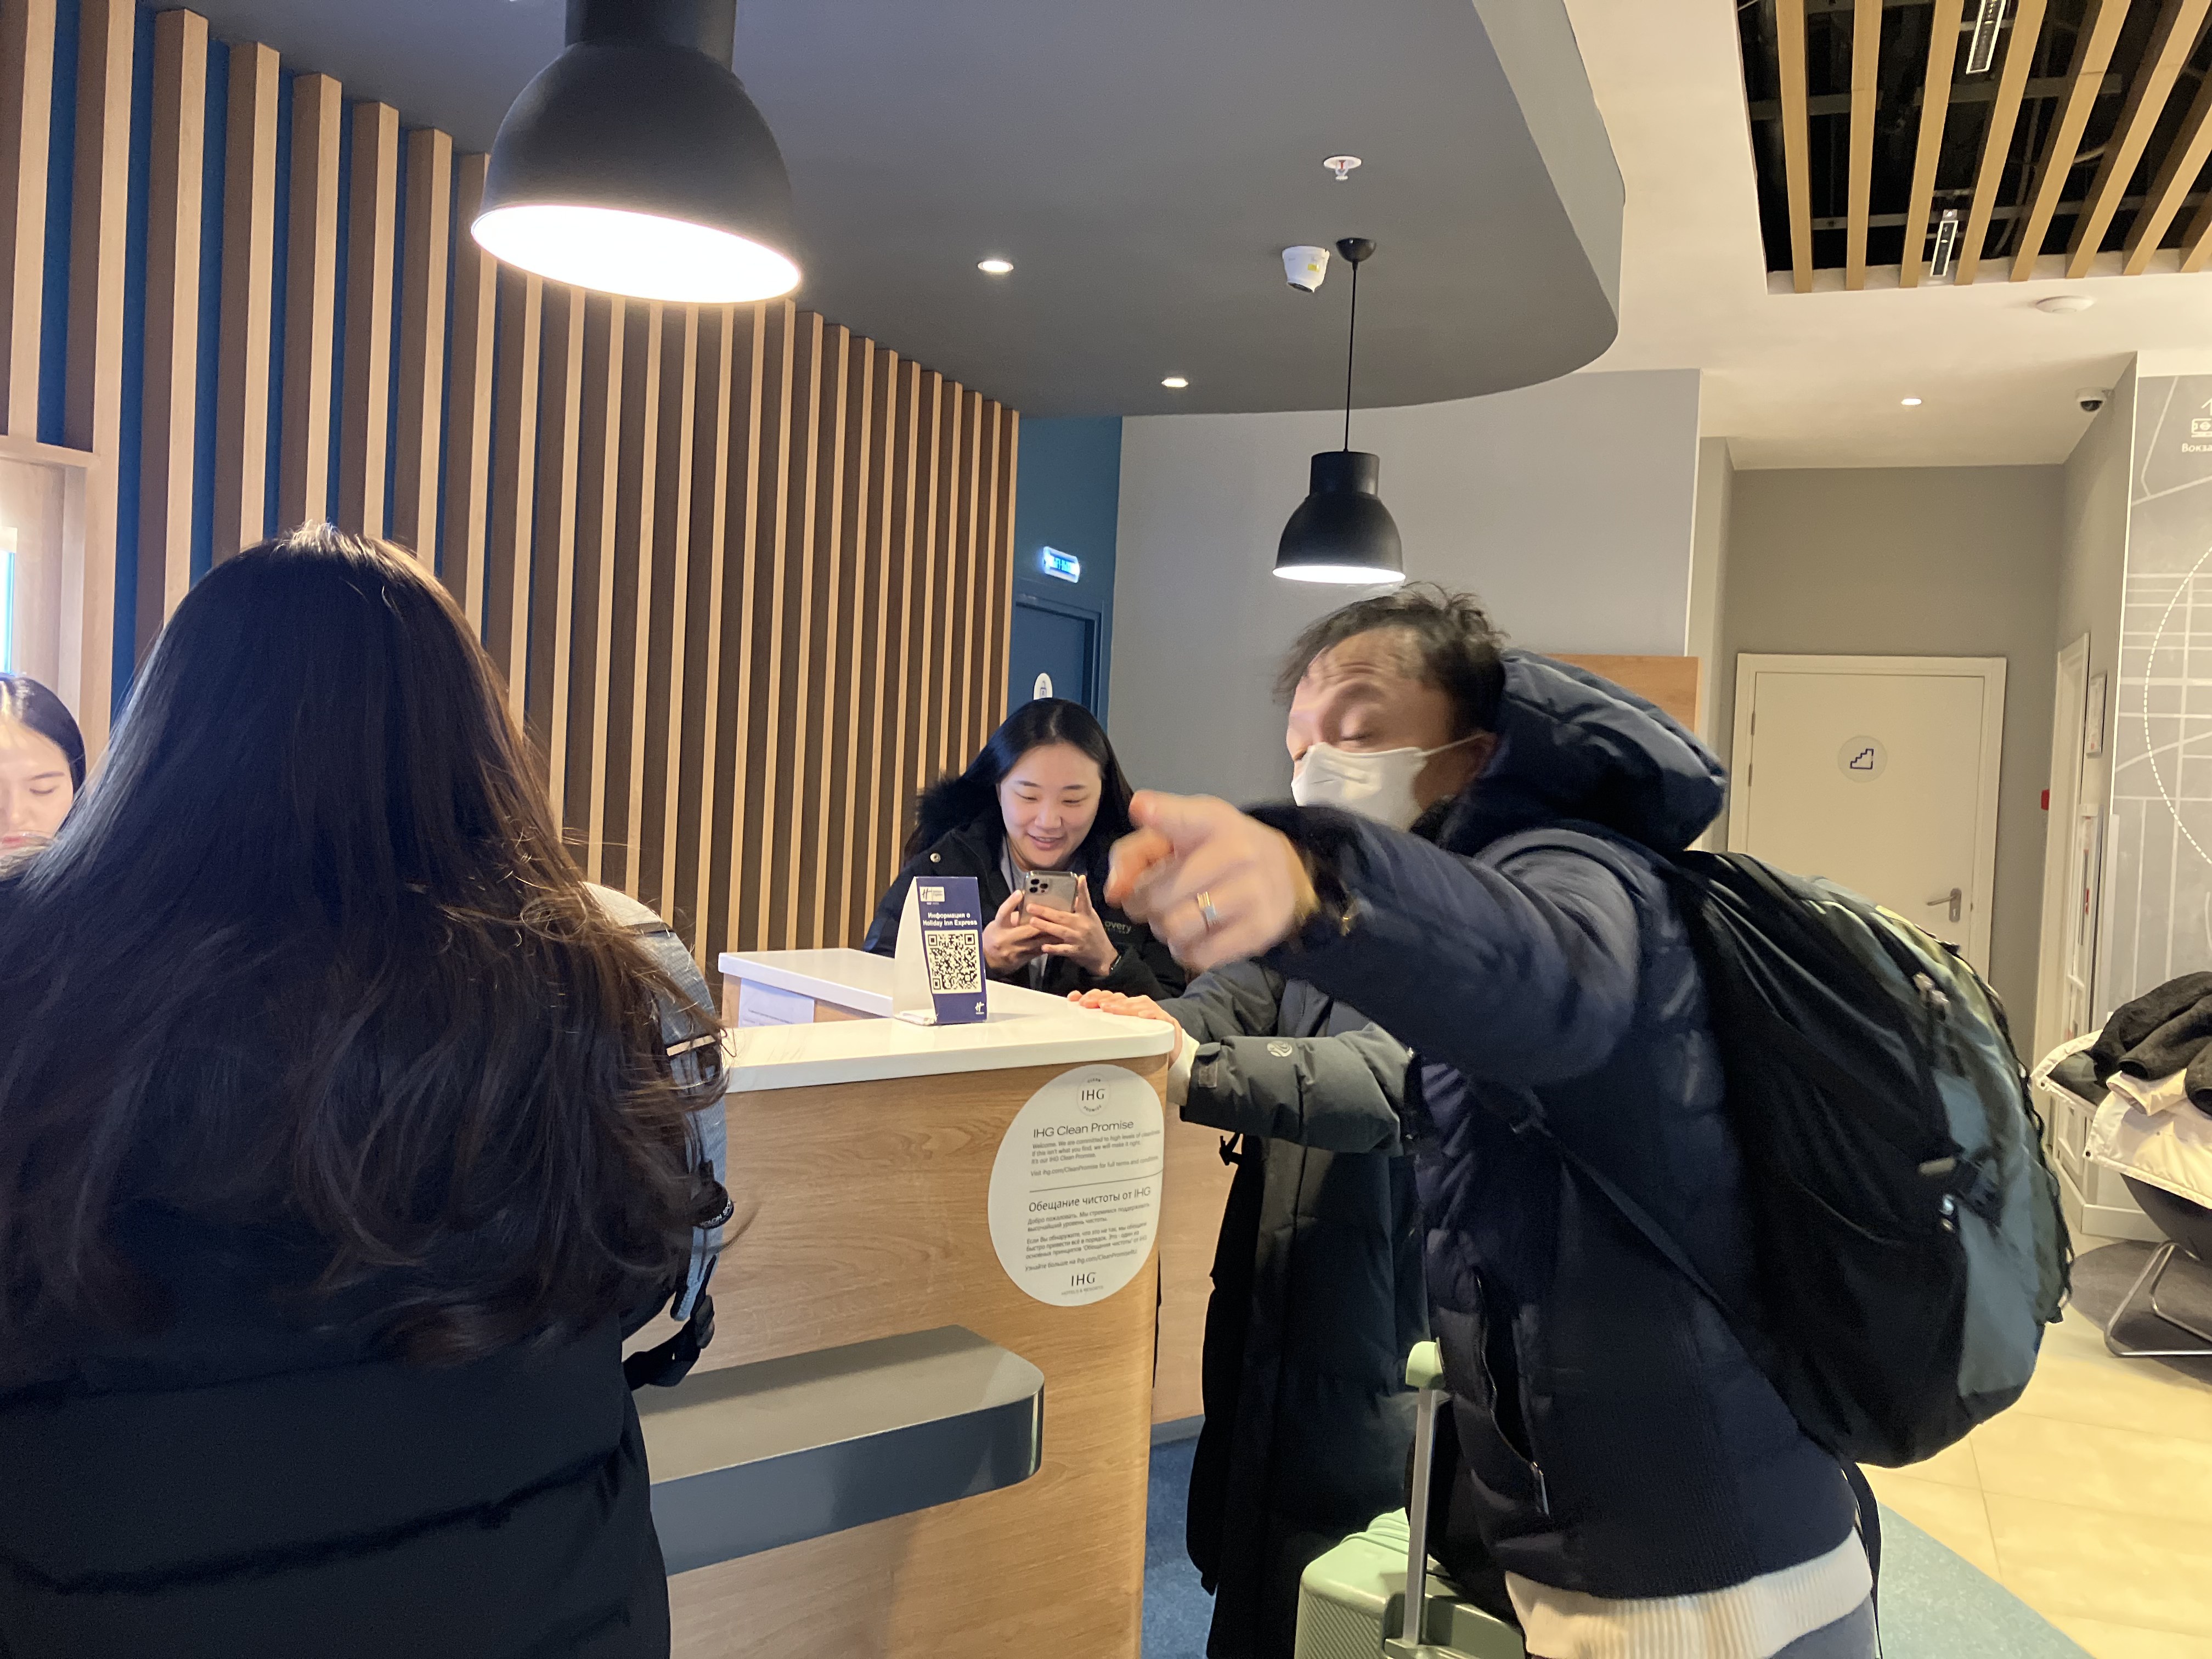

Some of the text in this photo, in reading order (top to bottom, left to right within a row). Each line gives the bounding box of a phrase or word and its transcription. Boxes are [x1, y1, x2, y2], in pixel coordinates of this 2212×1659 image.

[923, 919, 943, 928] Holiday
[1104, 921, 1131, 934] overy
[1082, 1089, 1105, 1101] IHG
[1033, 1120, 1134, 1138] IHG Clean Promise
[1029, 1187, 1151, 1212] Обещание чистоты от IHG
[1071, 1272, 1096, 1286] IHG
